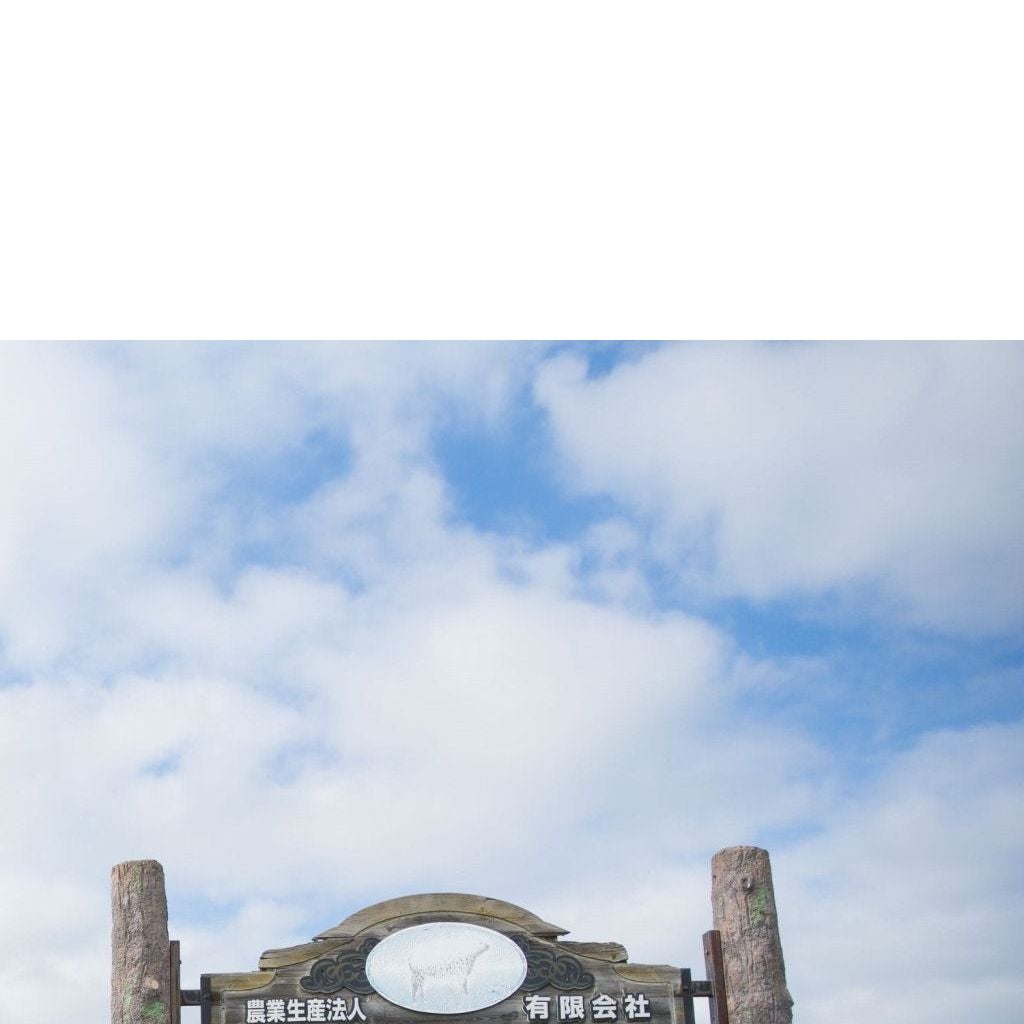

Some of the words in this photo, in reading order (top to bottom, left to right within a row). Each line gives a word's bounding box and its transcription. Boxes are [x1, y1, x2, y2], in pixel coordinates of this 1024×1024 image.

[247, 997, 367, 1023] 農業生産法人
[526, 994, 651, 1019] 有限会社
